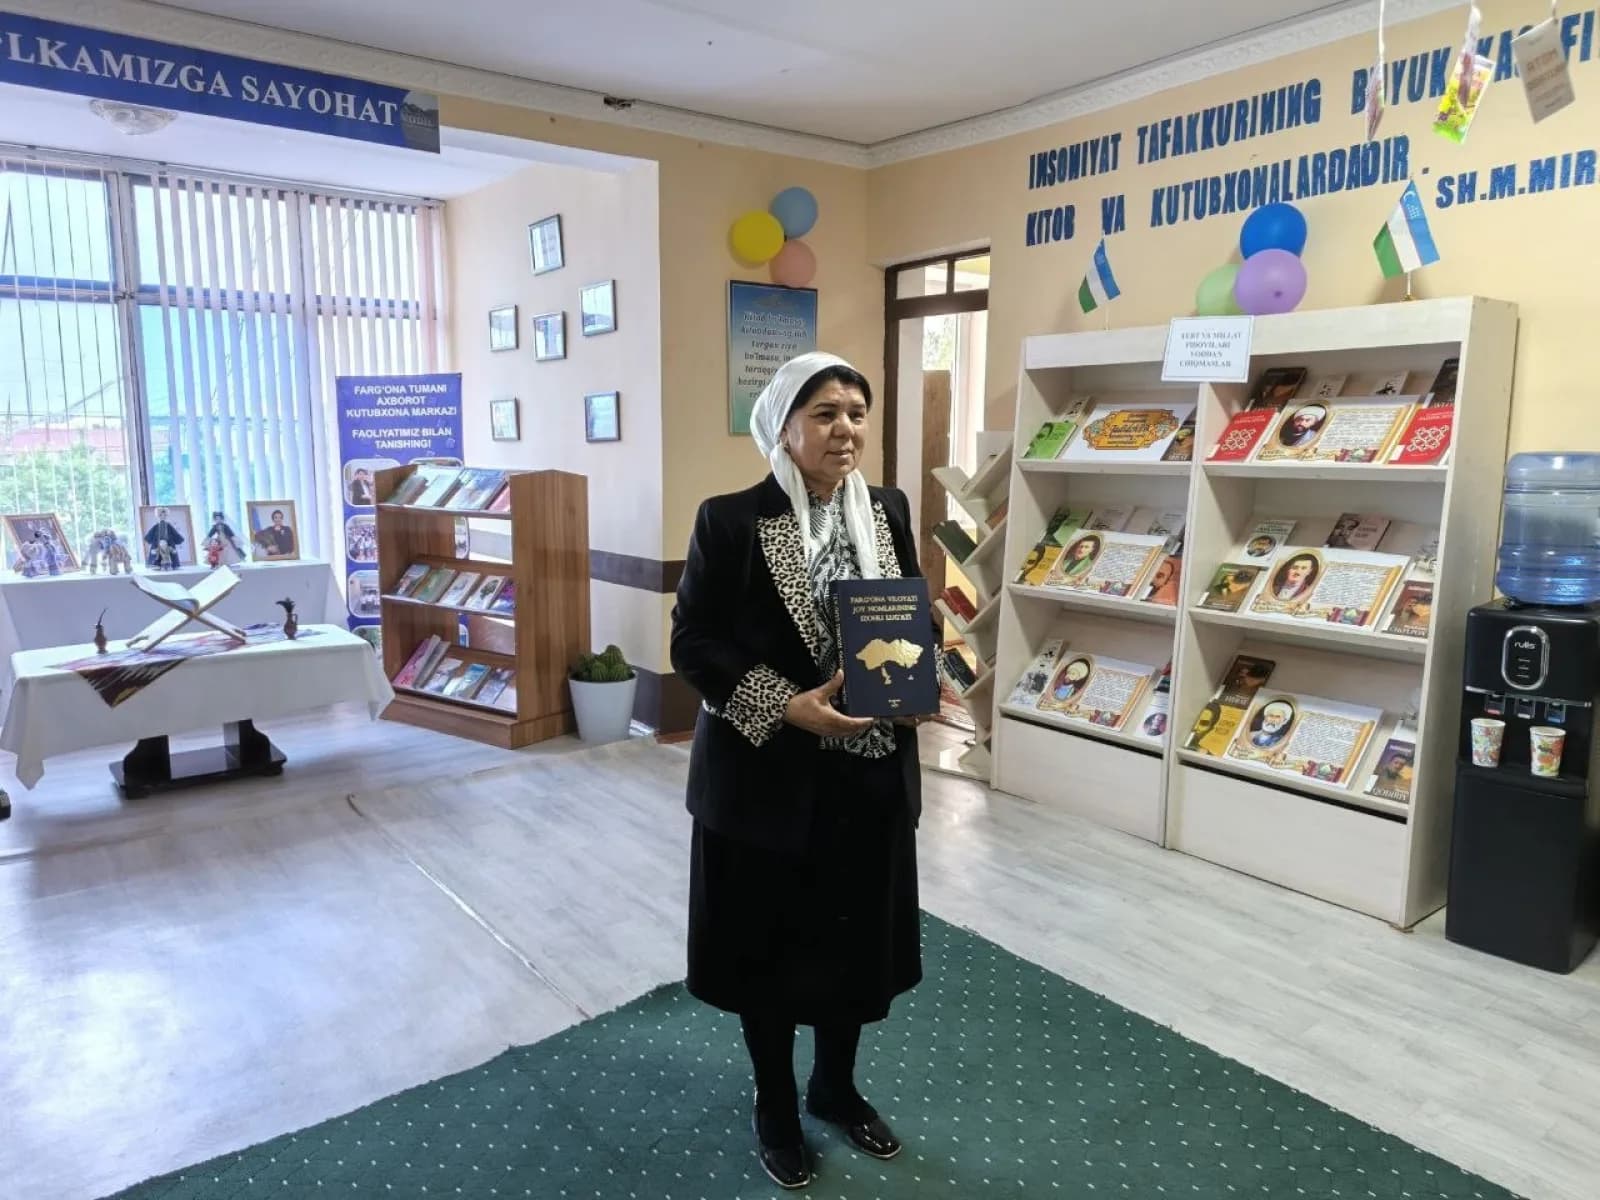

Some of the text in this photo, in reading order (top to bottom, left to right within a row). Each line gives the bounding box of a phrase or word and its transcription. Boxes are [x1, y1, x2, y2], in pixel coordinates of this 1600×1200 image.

[0, 32, 398, 126] LKAMIZGA SAYOHAT
[1028, 132, 1122, 190] INSONIYAT
[1137, 78, 1322, 165] TAFAKKURINING
[1026, 204, 1076, 247] KITOB
[1101, 194, 1126, 236] VA
[1435, 149, 1600, 209] SH.M.MIR
[409, 384, 447, 393] TUMANI
[376, 396, 426, 406] AXBOROT
[346, 406, 457, 417] KUTUBXONA MARKAZI
[352, 427, 452, 438] FAOLIYATIMIZ BILAN
[375, 440, 431, 449] TANISHING!
